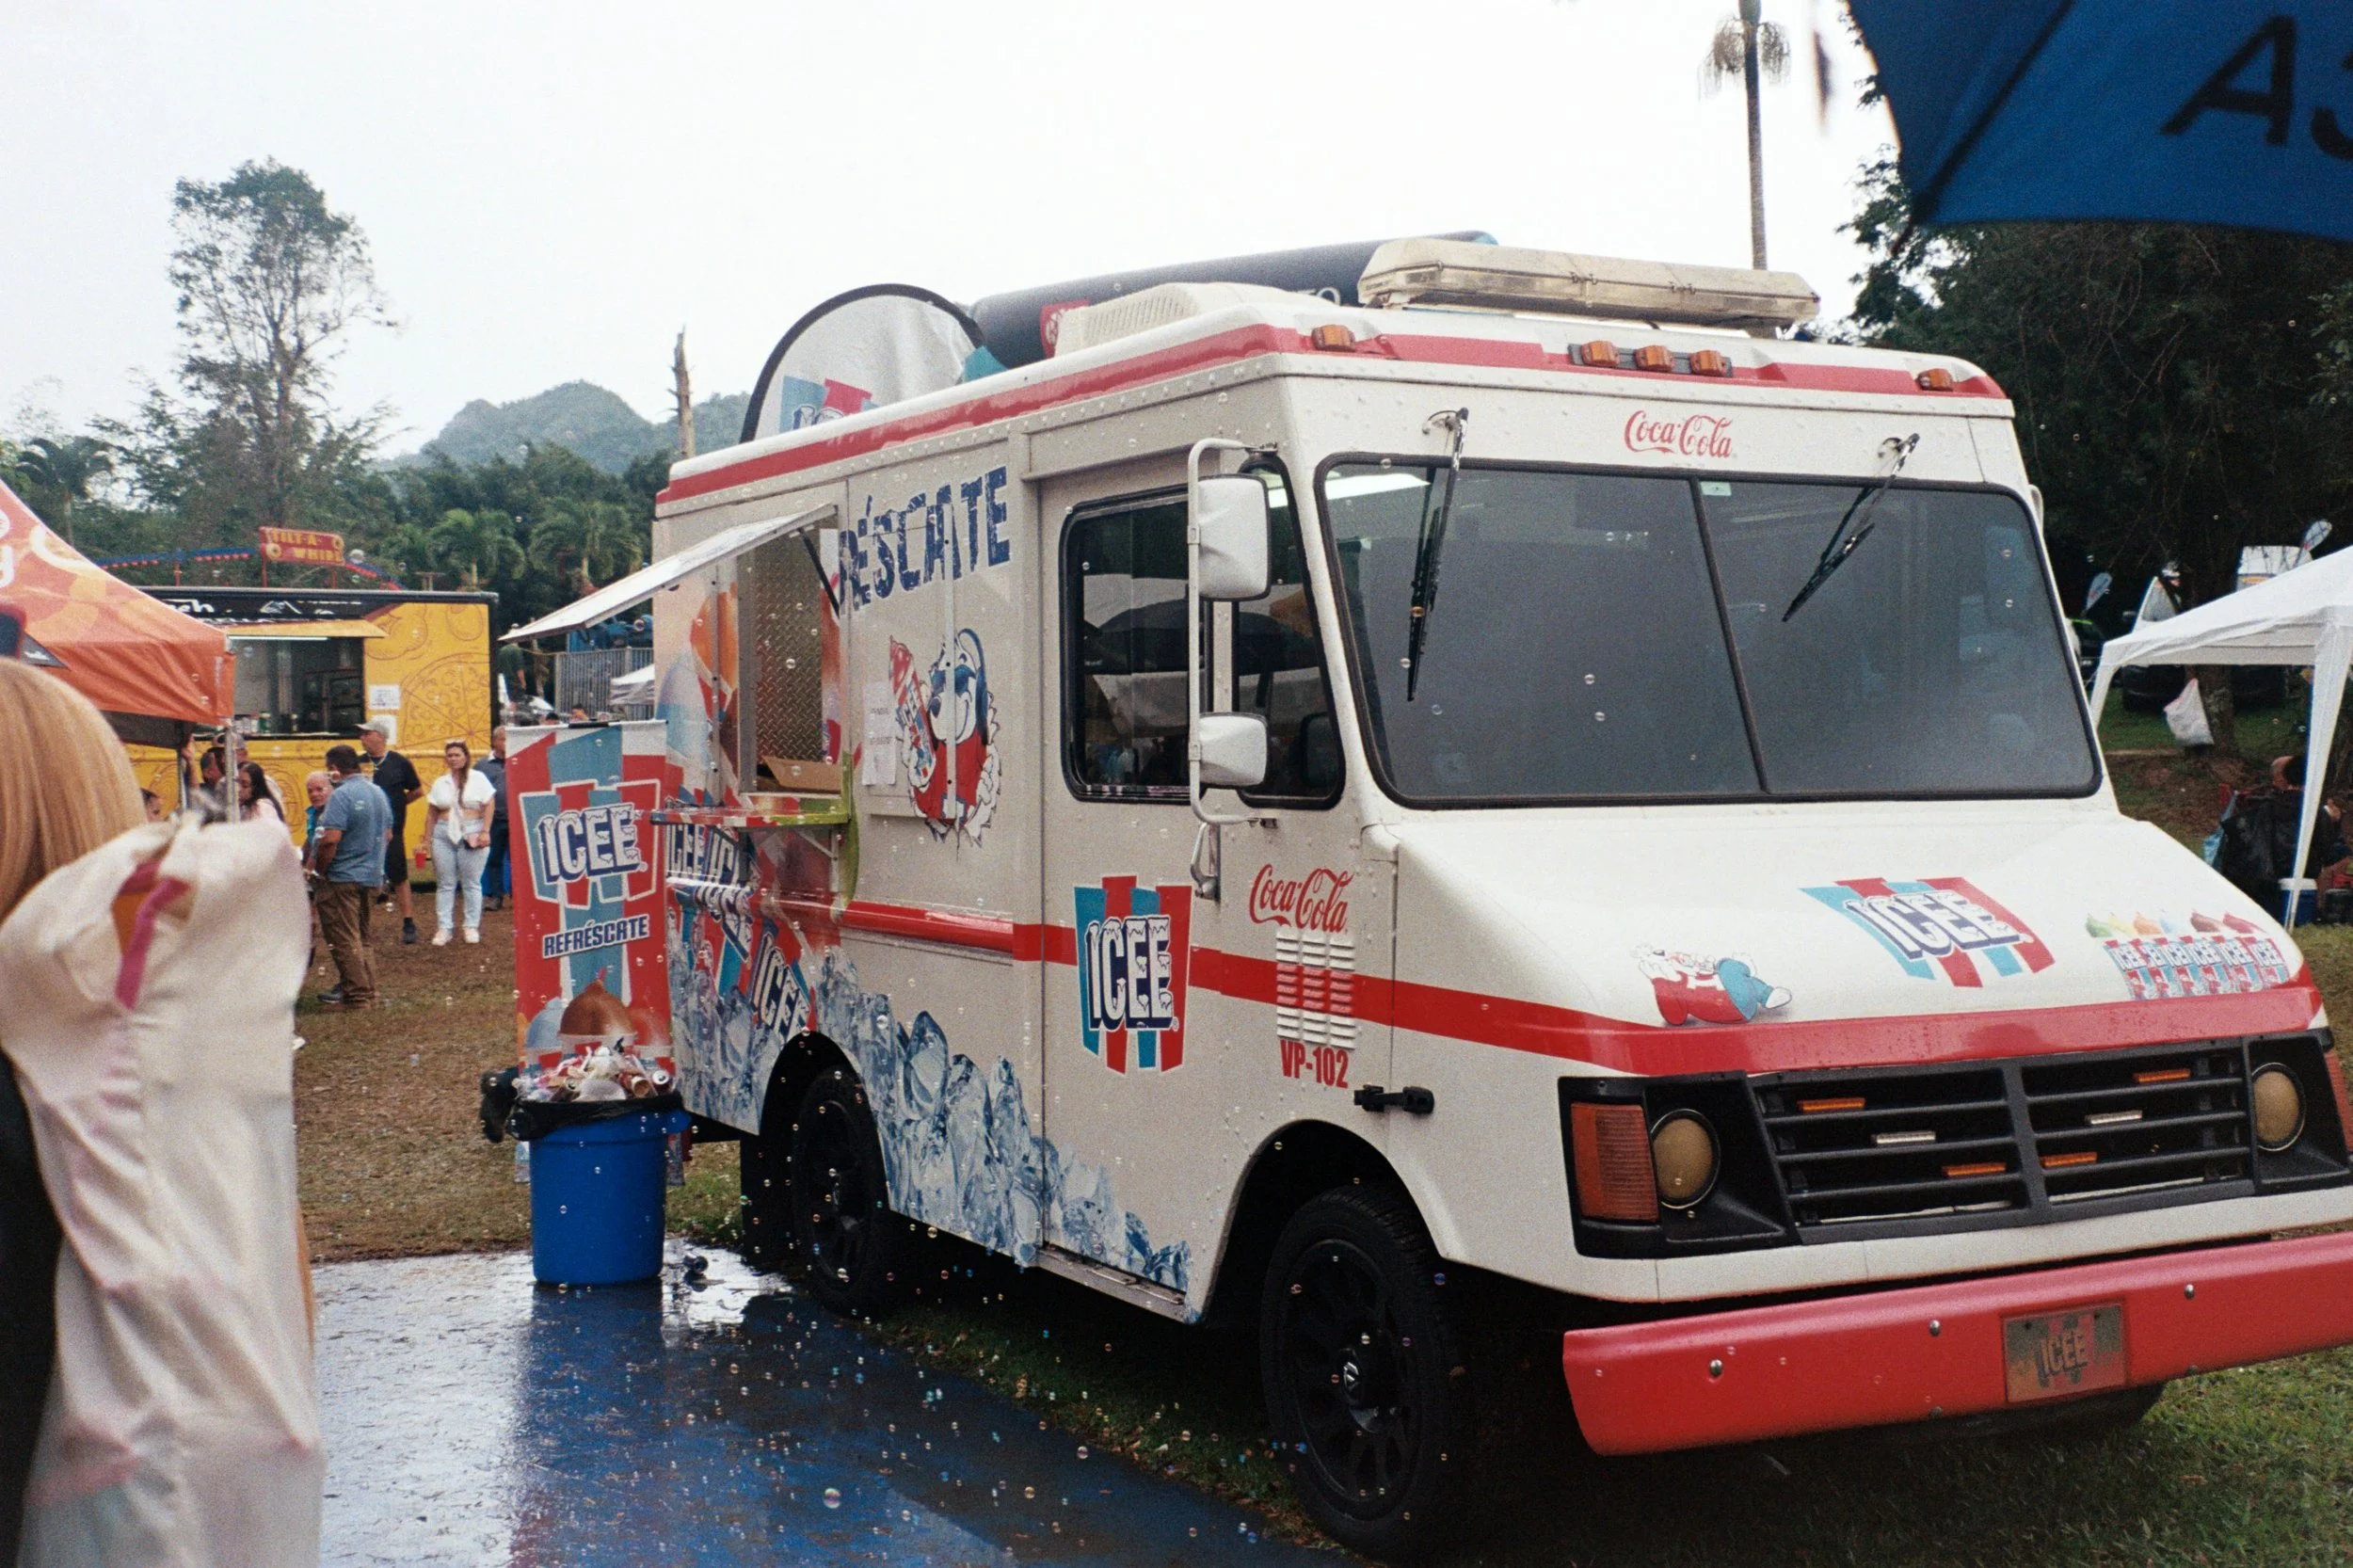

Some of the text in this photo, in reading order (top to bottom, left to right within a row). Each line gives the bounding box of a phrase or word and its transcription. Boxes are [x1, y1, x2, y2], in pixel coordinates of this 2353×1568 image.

[1625, 409, 1732, 458] Coca-Cola
[538, 802, 642, 885] ICEE
[1249, 864, 1353, 933] Coca-Cola
[1844, 891, 2022, 960] ICEE
[1086, 917, 1174, 1030] ICEE
[1280, 1039, 1349, 1089] VP-102
[2036, 1330, 2089, 1378] ICEE
